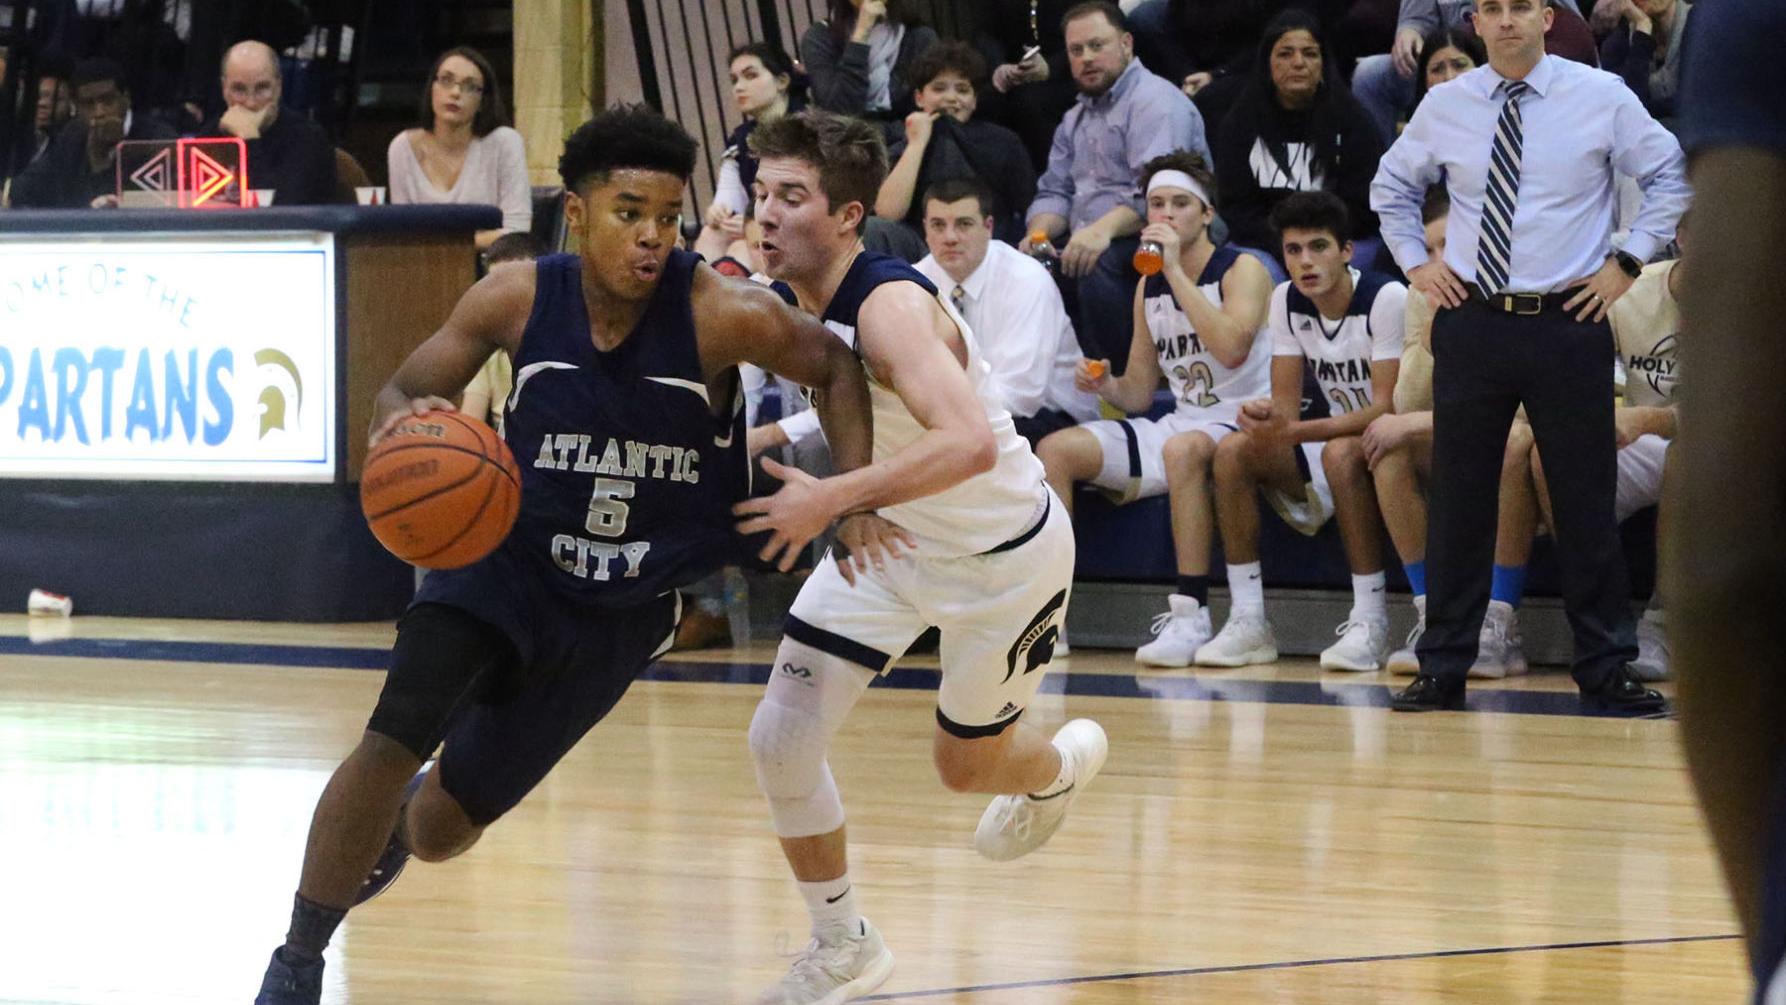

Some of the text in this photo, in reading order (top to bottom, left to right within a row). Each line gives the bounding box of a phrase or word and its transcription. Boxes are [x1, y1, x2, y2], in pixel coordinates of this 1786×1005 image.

[88, 262, 127, 294] OF
[144, 272, 200, 328] THE
[1173, 361, 1221, 408] 22
[1629, 355, 1677, 375] HOLY
[534, 434, 700, 484] ATLANTIC
[585, 477, 635, 537] 5
[552, 534, 650, 581] CITY
